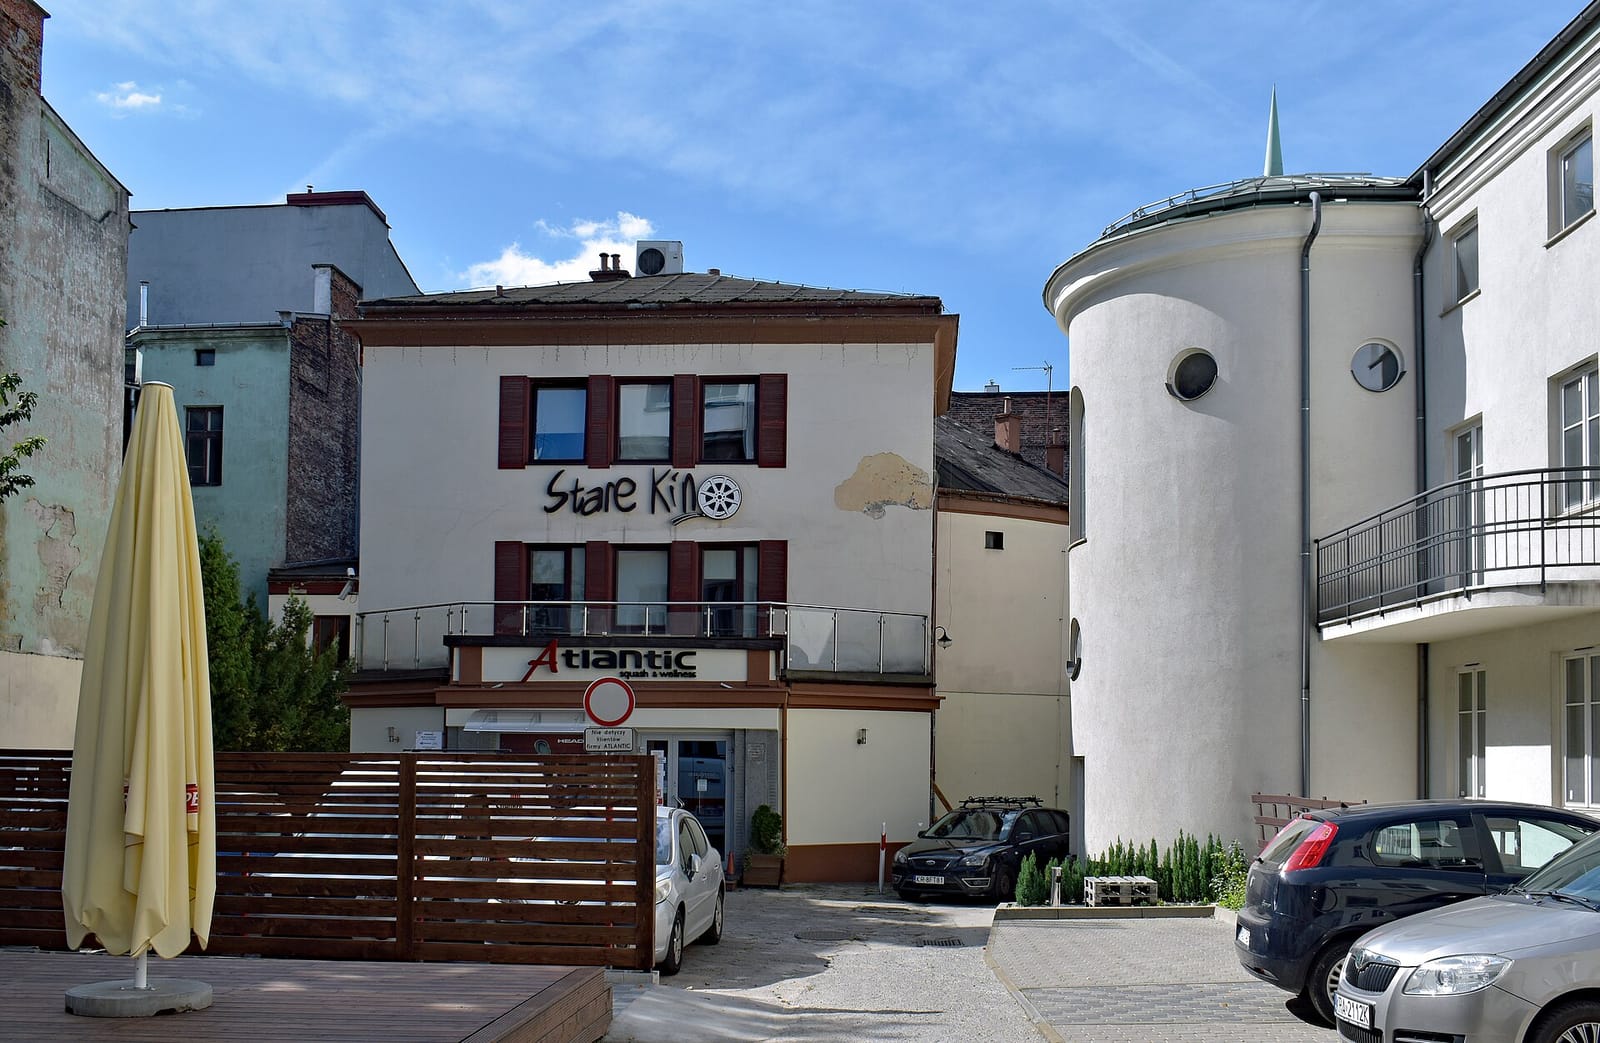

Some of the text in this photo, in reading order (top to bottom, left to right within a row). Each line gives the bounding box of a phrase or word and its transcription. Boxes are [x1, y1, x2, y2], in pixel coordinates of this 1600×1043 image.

[543, 469, 637, 516] Stare
[520, 638, 697, 683] Atlantic
[619, 670, 648, 680] squash
[659, 670, 697, 678] wellness
